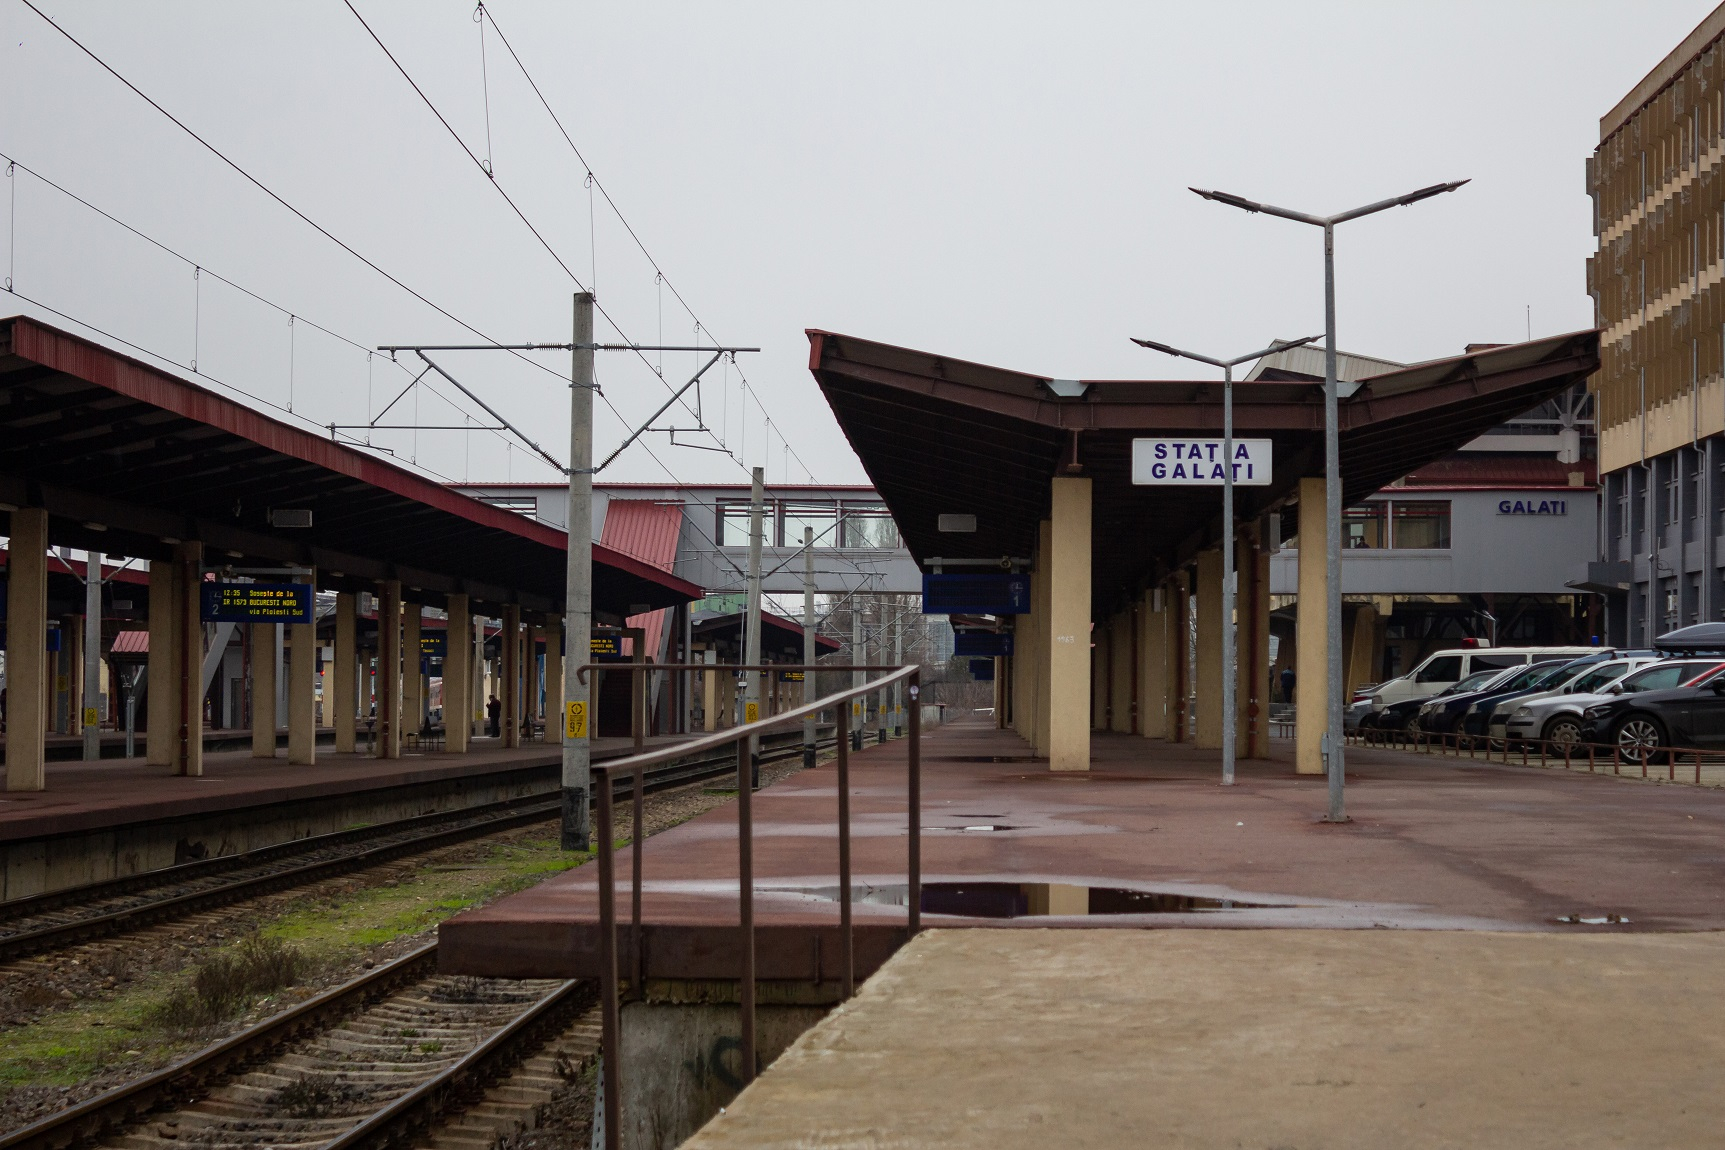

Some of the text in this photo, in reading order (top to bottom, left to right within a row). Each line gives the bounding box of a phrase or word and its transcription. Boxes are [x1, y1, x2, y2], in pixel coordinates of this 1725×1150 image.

[1154, 443, 1250, 463] STAȚA
[223, 589, 241, 597] 12:35
[1013, 595, 1019, 607] 1
[212, 604, 218, 614] 2
